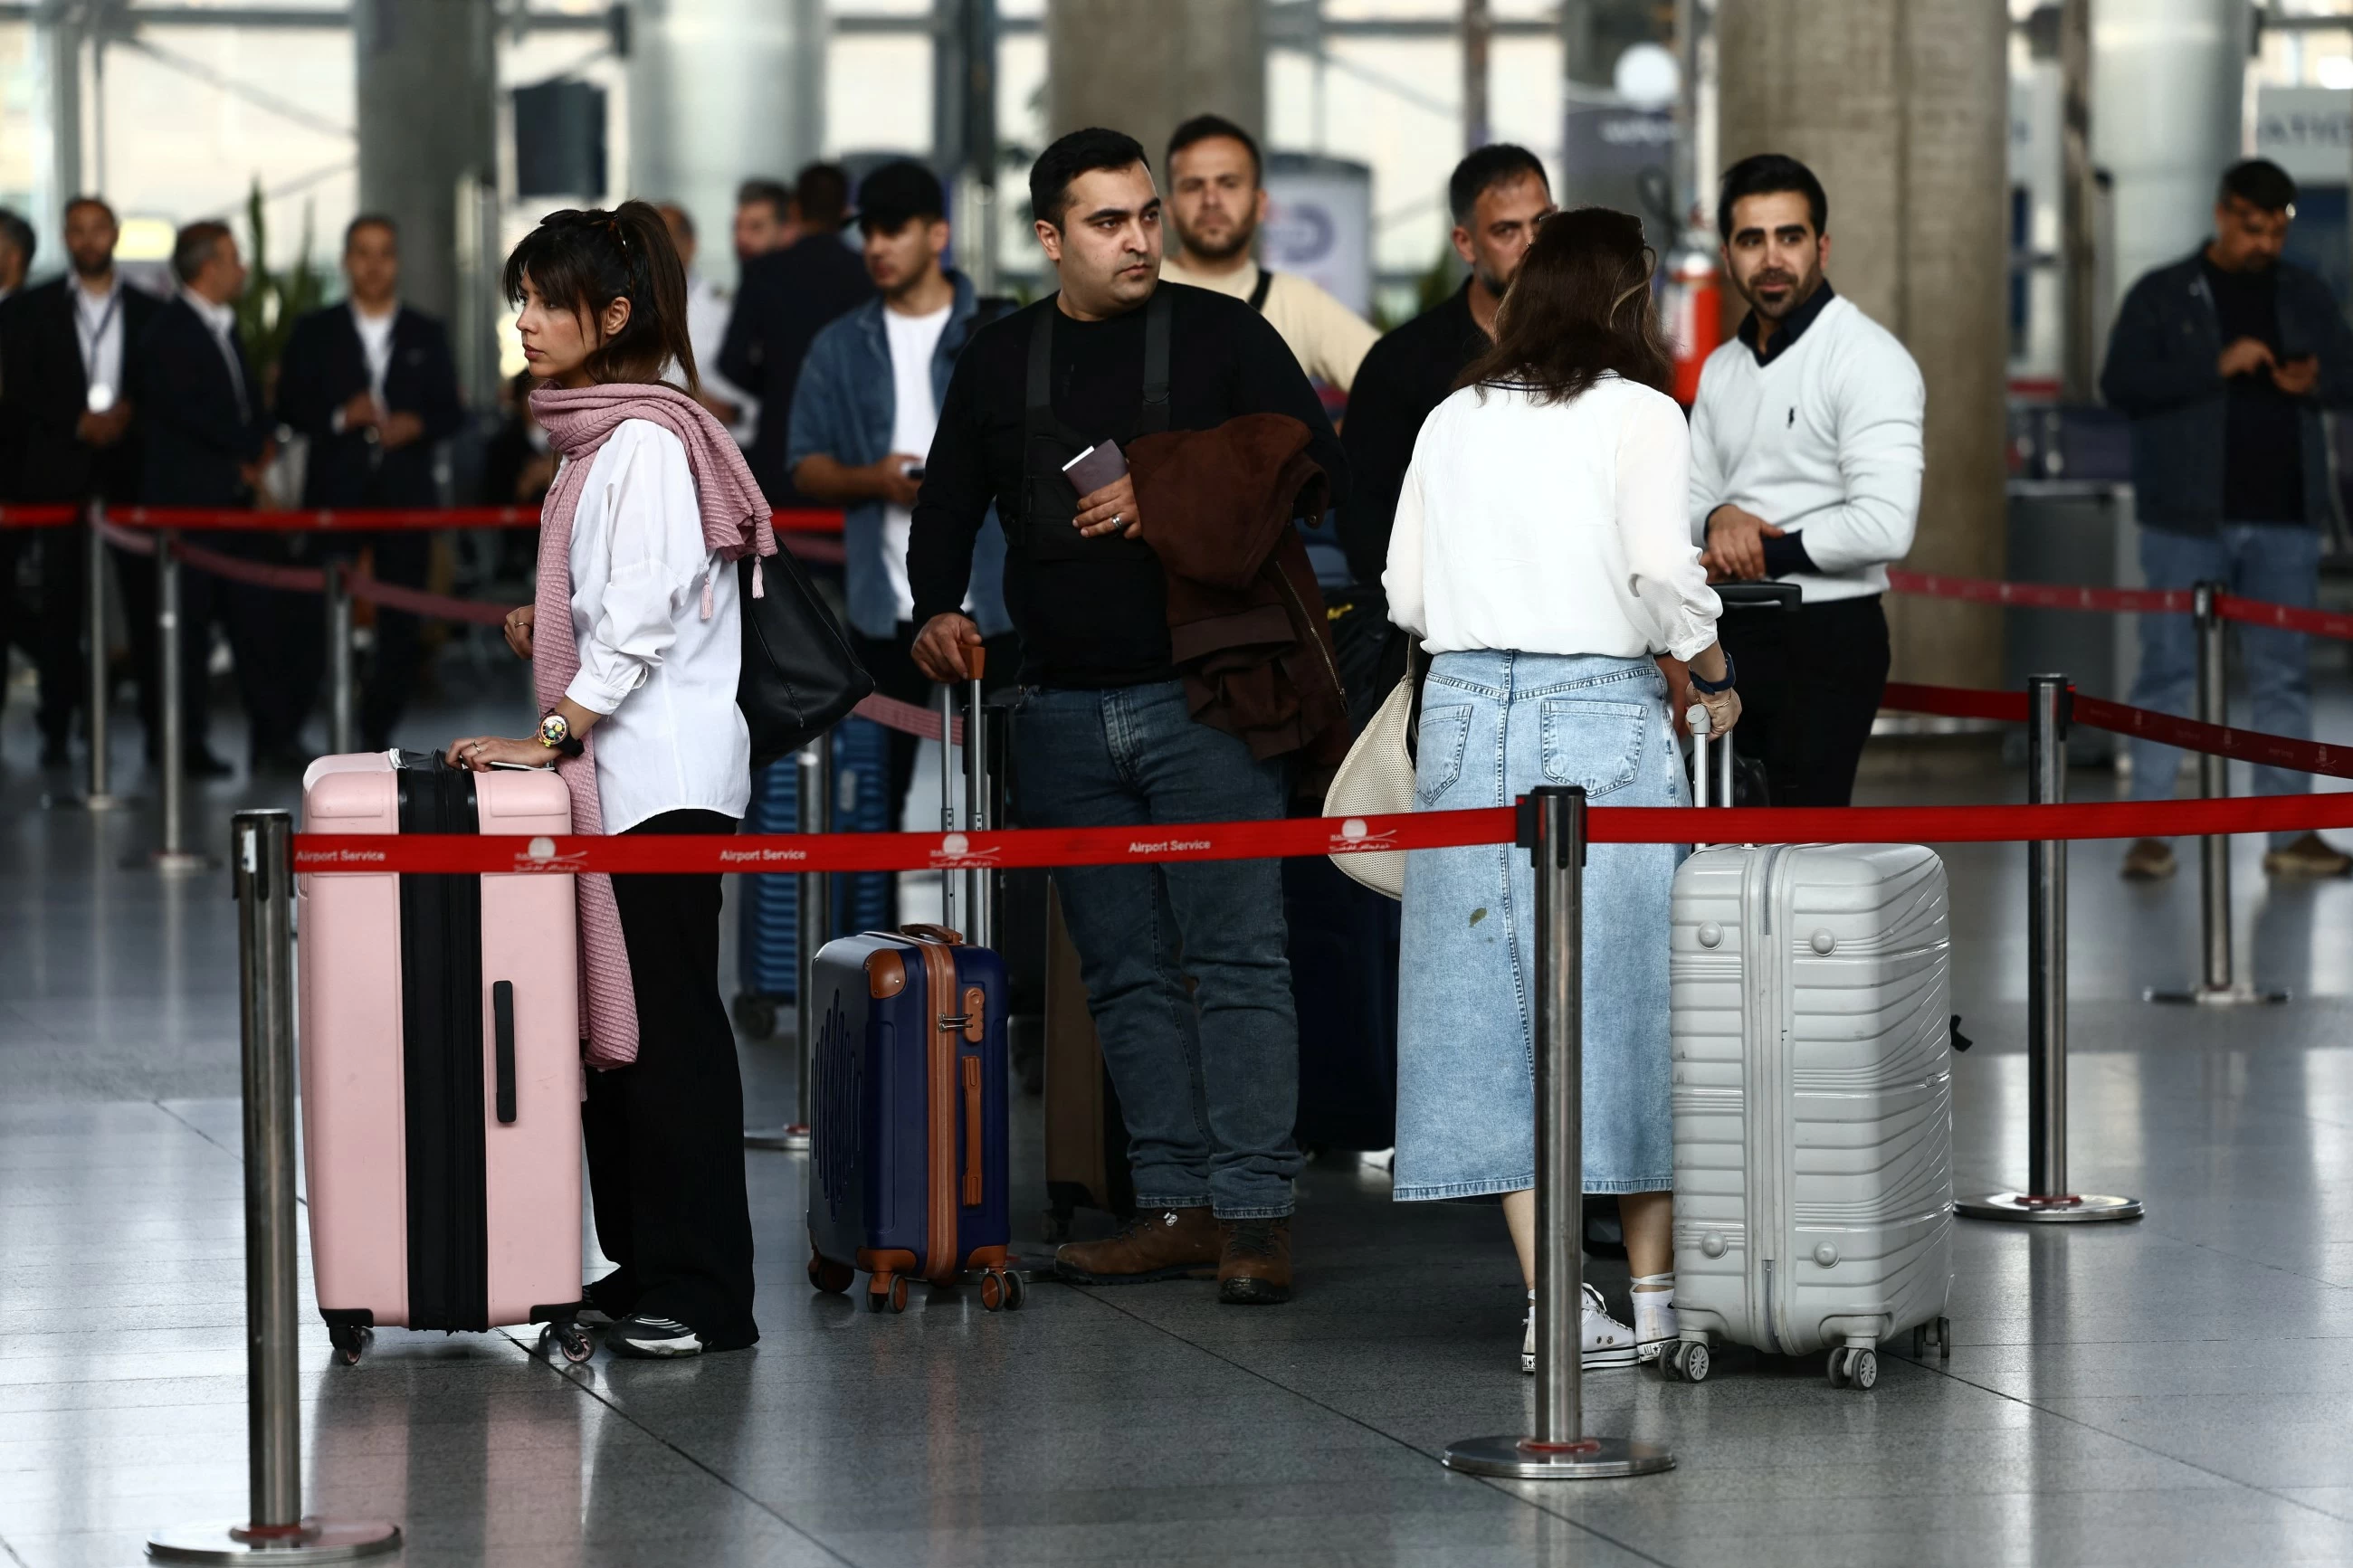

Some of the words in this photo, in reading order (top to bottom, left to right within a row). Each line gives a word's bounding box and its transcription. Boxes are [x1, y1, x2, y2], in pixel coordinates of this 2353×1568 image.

[1129, 841, 1167, 854] Airport
[1170, 840, 1211, 851] Service
[295, 850, 338, 863] Airport
[340, 849, 386, 861] Service
[719, 850, 760, 863] Airport
[762, 849, 806, 860] Service
